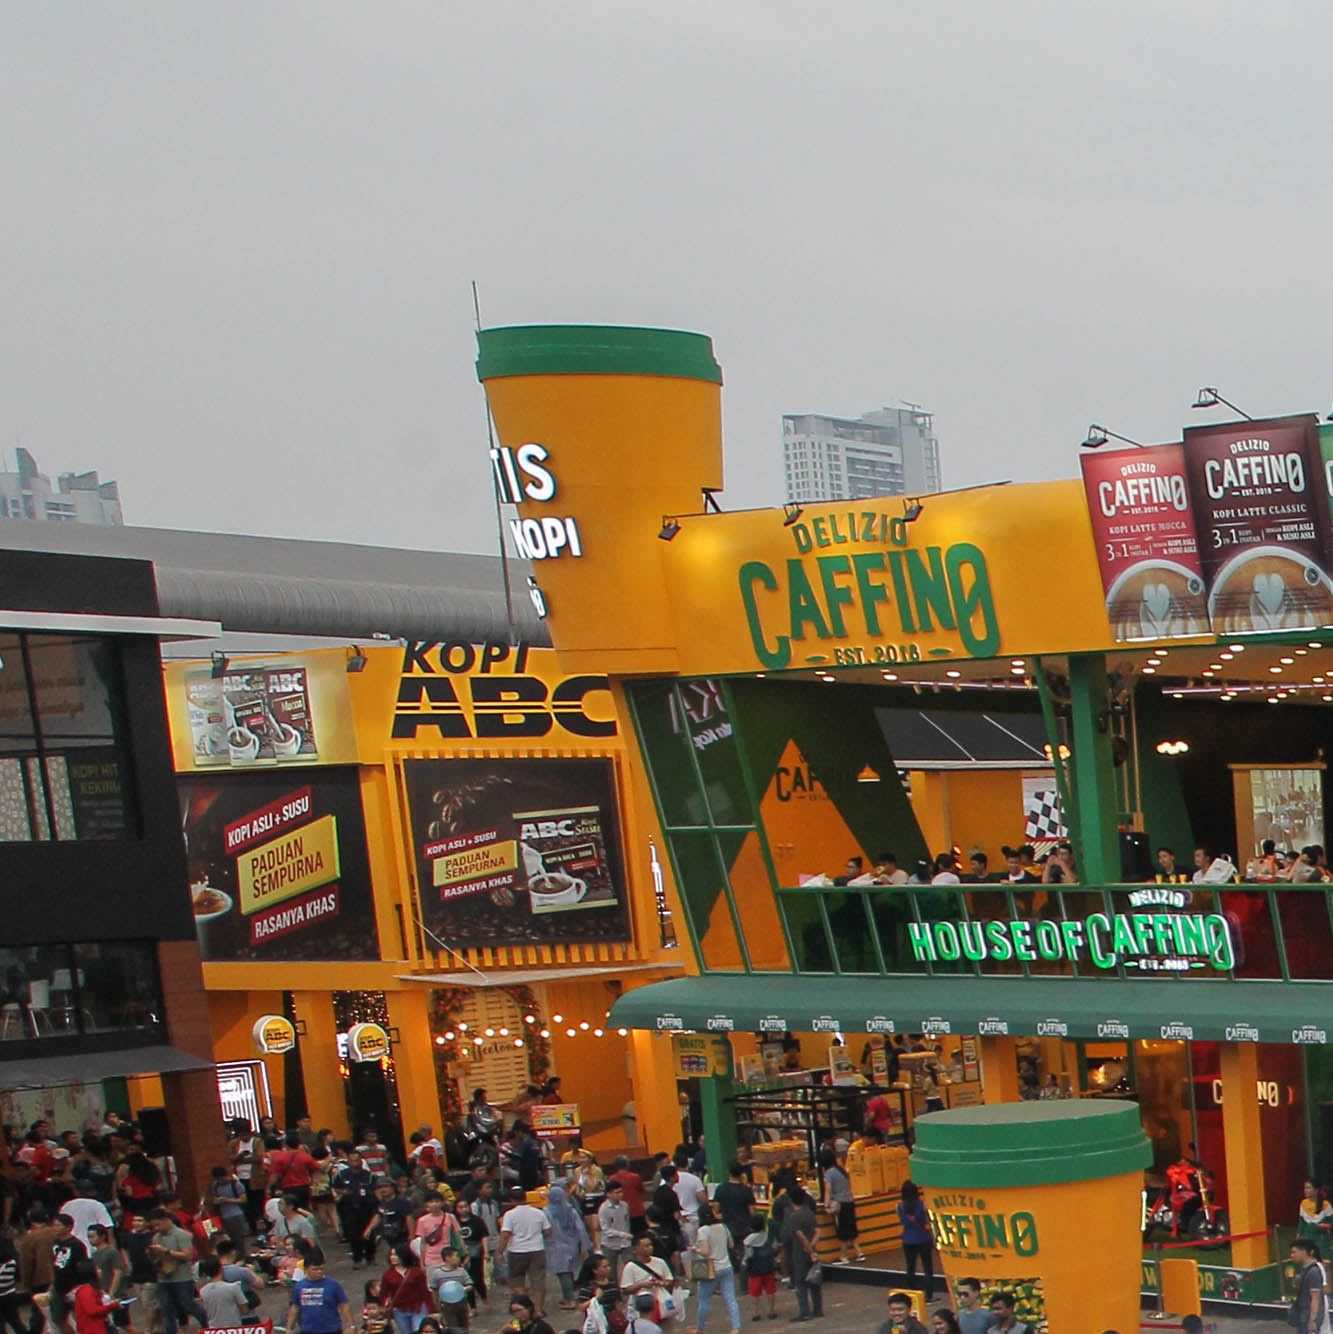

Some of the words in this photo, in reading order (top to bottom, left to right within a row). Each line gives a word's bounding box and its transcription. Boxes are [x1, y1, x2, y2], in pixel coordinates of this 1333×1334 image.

[1230, 439, 1270, 454] DELIZIO
[1121, 463, 1156, 476] DELIZIO
[1205, 452, 1305, 499] CAFFINO
[1099, 475, 1188, 517] CAFFINO
[1213, 509, 1235, 519] KOPI
[1237, 506, 1267, 517] LATTE
[1269, 504, 1308, 515] CLASSIC
[510, 516, 584, 560] KOPI
[792, 511, 909, 553] DELIZIO
[1109, 526, 1129, 535] KOPI
[1130, 524, 1156, 533] LATTE
[1158, 521, 1188, 531] MOCCA
[1211, 529, 1222, 549] 3
[1230, 529, 1239, 544] 1
[1106, 544, 1115, 560] 3
[1121, 543, 1129, 557] 1
[738, 542, 1001, 671] CAFFINO
[401, 640, 533, 675] KOPI
[269, 672, 304, 694] ABC
[391, 676, 618, 738] ABC
[228, 824, 250, 847] KOPI
[252, 812, 274, 837] ASLI
[282, 796, 310, 822] SUSU
[520, 819, 576, 840] ABC
[251, 836, 304, 878] PADUAN
[427, 844, 446, 855] KOPI
[448, 838, 467, 851] ASLI
[474, 831, 497, 843] SUSU
[445, 849, 490, 869] PADUAN
[445, 856, 506, 880] SEMPURNA
[253, 850, 324, 899] SEMPURNA
[444, 883, 488, 898] RASANYA
[489, 874, 513, 890] KHAS
[255, 905, 305, 938] RASANYA
[306, 893, 336, 920] KHAS
[908, 920, 1037, 962] HOUSE
[1036, 920, 1084, 962] OF
[1086, 913, 1236, 971] CAFFINO
